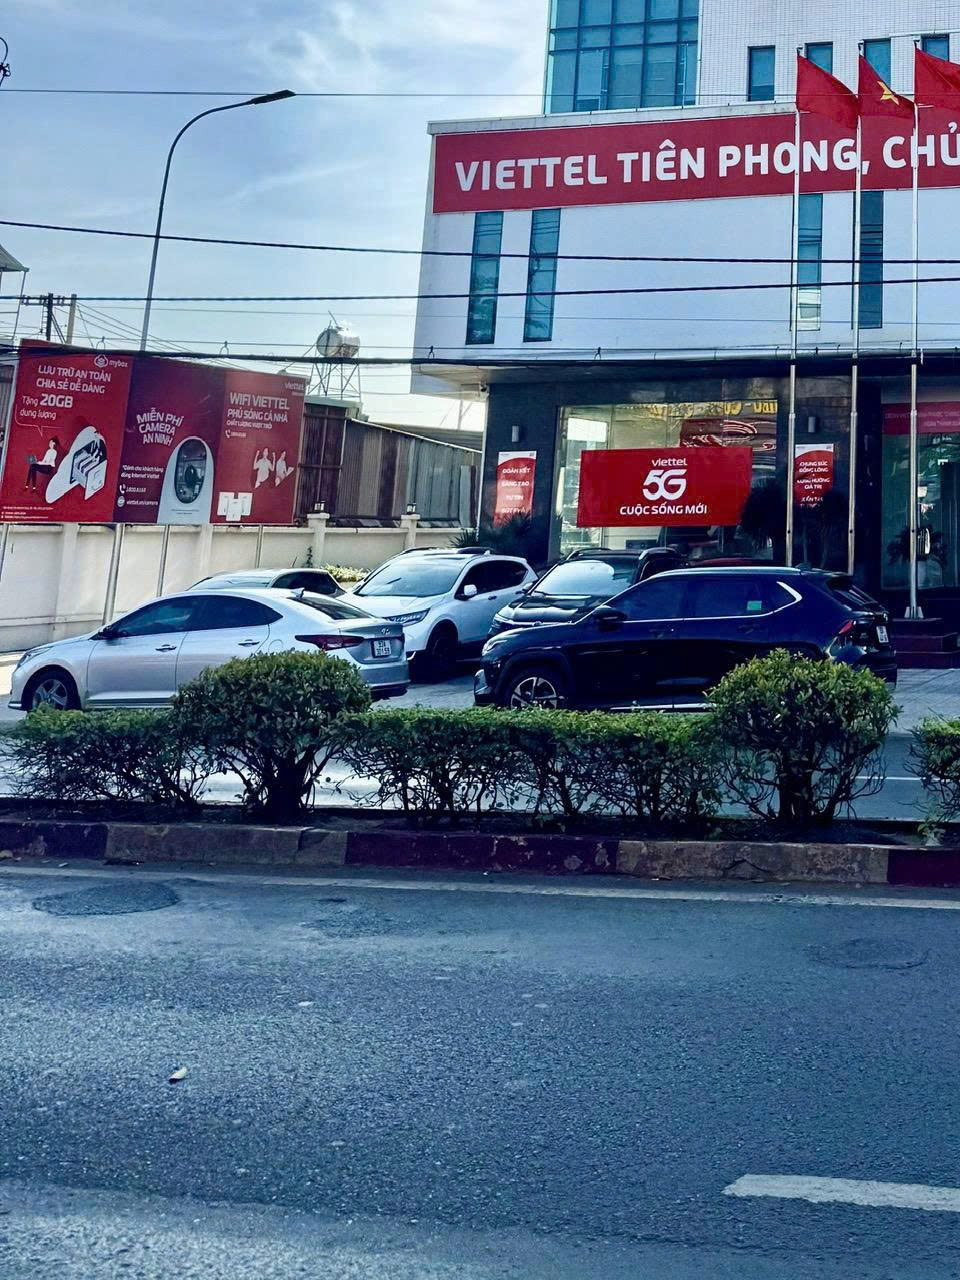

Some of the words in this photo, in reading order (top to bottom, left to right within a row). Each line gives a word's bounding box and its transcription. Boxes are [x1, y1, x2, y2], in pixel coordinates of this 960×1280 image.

[455, 154, 607, 192] VIETTEL
[617, 138, 705, 183] TIÊN
[718, 138, 870, 179] PHONG,
[38, 365, 56, 375] LƯU
[57, 367, 74, 377] TRỮ
[74, 370, 87, 378] AN
[89, 370, 112, 382] TOÀN
[36, 378, 56, 389] CHIA
[82, 381, 106, 394] DÀNG
[22, 395, 38, 406] Tặng
[39, 393, 73, 408] 20GB
[230, 392, 251, 406] WIFI
[252, 395, 290, 410] VIETTEL
[20, 408, 37, 419] dung
[136, 408, 164, 424] MIỄN
[165, 413, 184, 427] PHÍ
[243, 409, 263, 420] SÓNG
[273, 412, 288, 423] NHÀ
[139, 423, 176, 436] CAMERA
[143, 433, 154, 444] AN
[154, 433, 173, 446] NINH
[652, 458, 688, 467] viettel
[642, 469, 688, 501] 5G
[620, 503, 650, 516] CUỘC
[651, 501, 683, 515] SỐNG
[685, 502, 707, 514] MỚI
